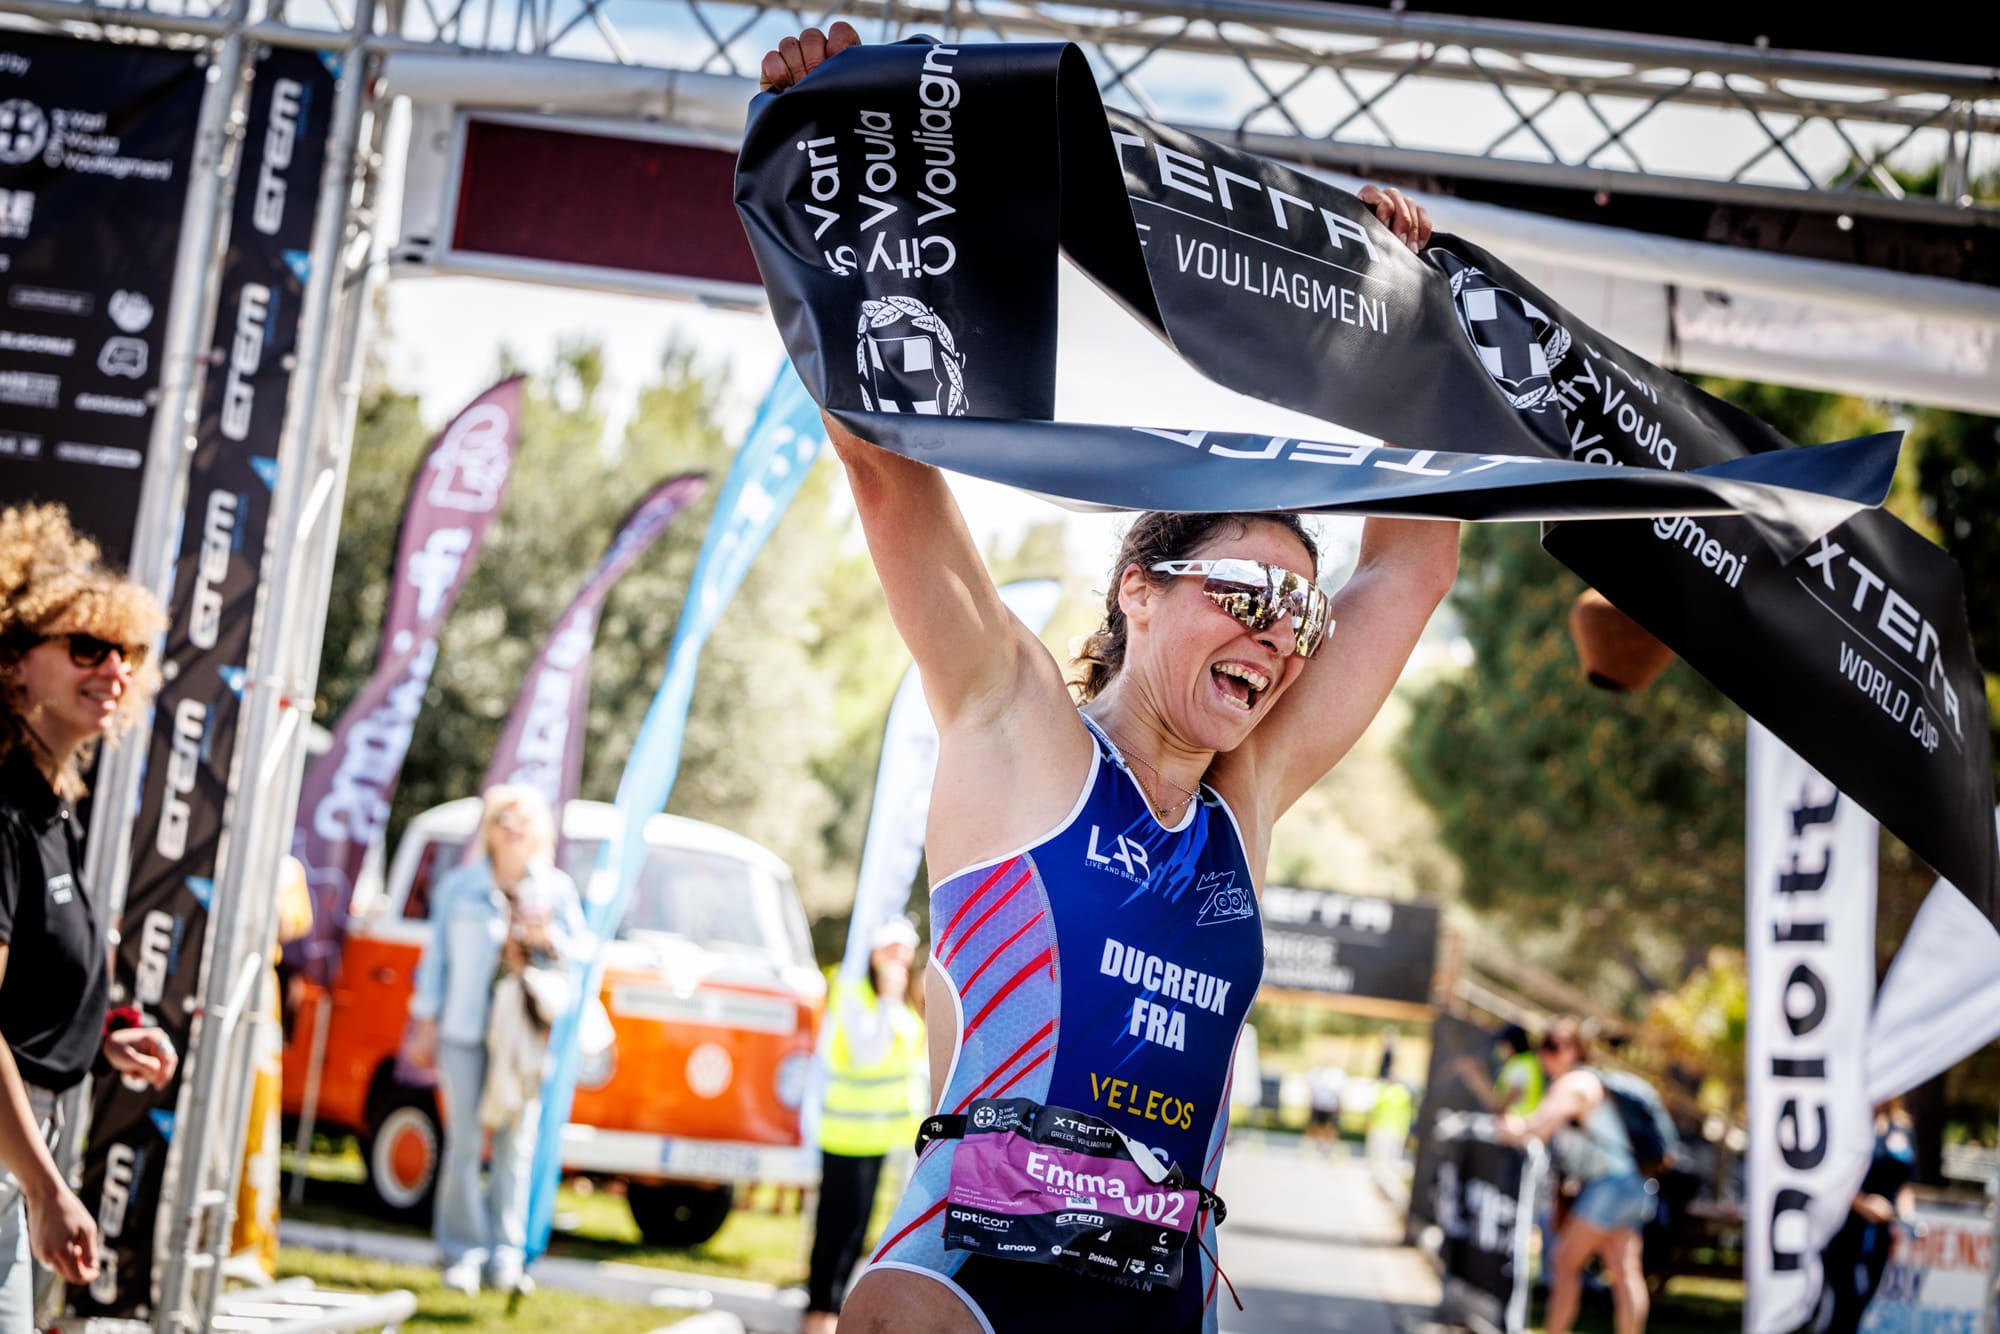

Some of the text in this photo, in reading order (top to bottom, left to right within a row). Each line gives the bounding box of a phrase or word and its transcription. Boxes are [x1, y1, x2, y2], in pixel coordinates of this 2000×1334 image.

[796, 135, 841, 242] Vari
[853, 109, 899, 233] Voula
[1110, 130, 1380, 263] TERRA
[865, 230, 957, 279] City
[1175, 233, 1389, 335] VOULIAGMENI
[1557, 357, 1603, 419] ity
[1602, 374, 1678, 471] Voula
[1838, 640, 1940, 754] WORLD CUP
[1085, 859, 1150, 890] LIVE AND BREATHE
[1099, 937, 1232, 1016] DUCREUX
[1128, 997, 1187, 1052] FRA
[1771, 786, 1842, 1272] Deloitt
[1053, 1116, 1116, 1137] XTERRA
[1089, 1072, 1195, 1131] VELEOS
[1026, 1151, 1125, 1199] Emma
[951, 1210, 1010, 1229] apticon
[997, 1242, 1037, 1253] Lenovo
